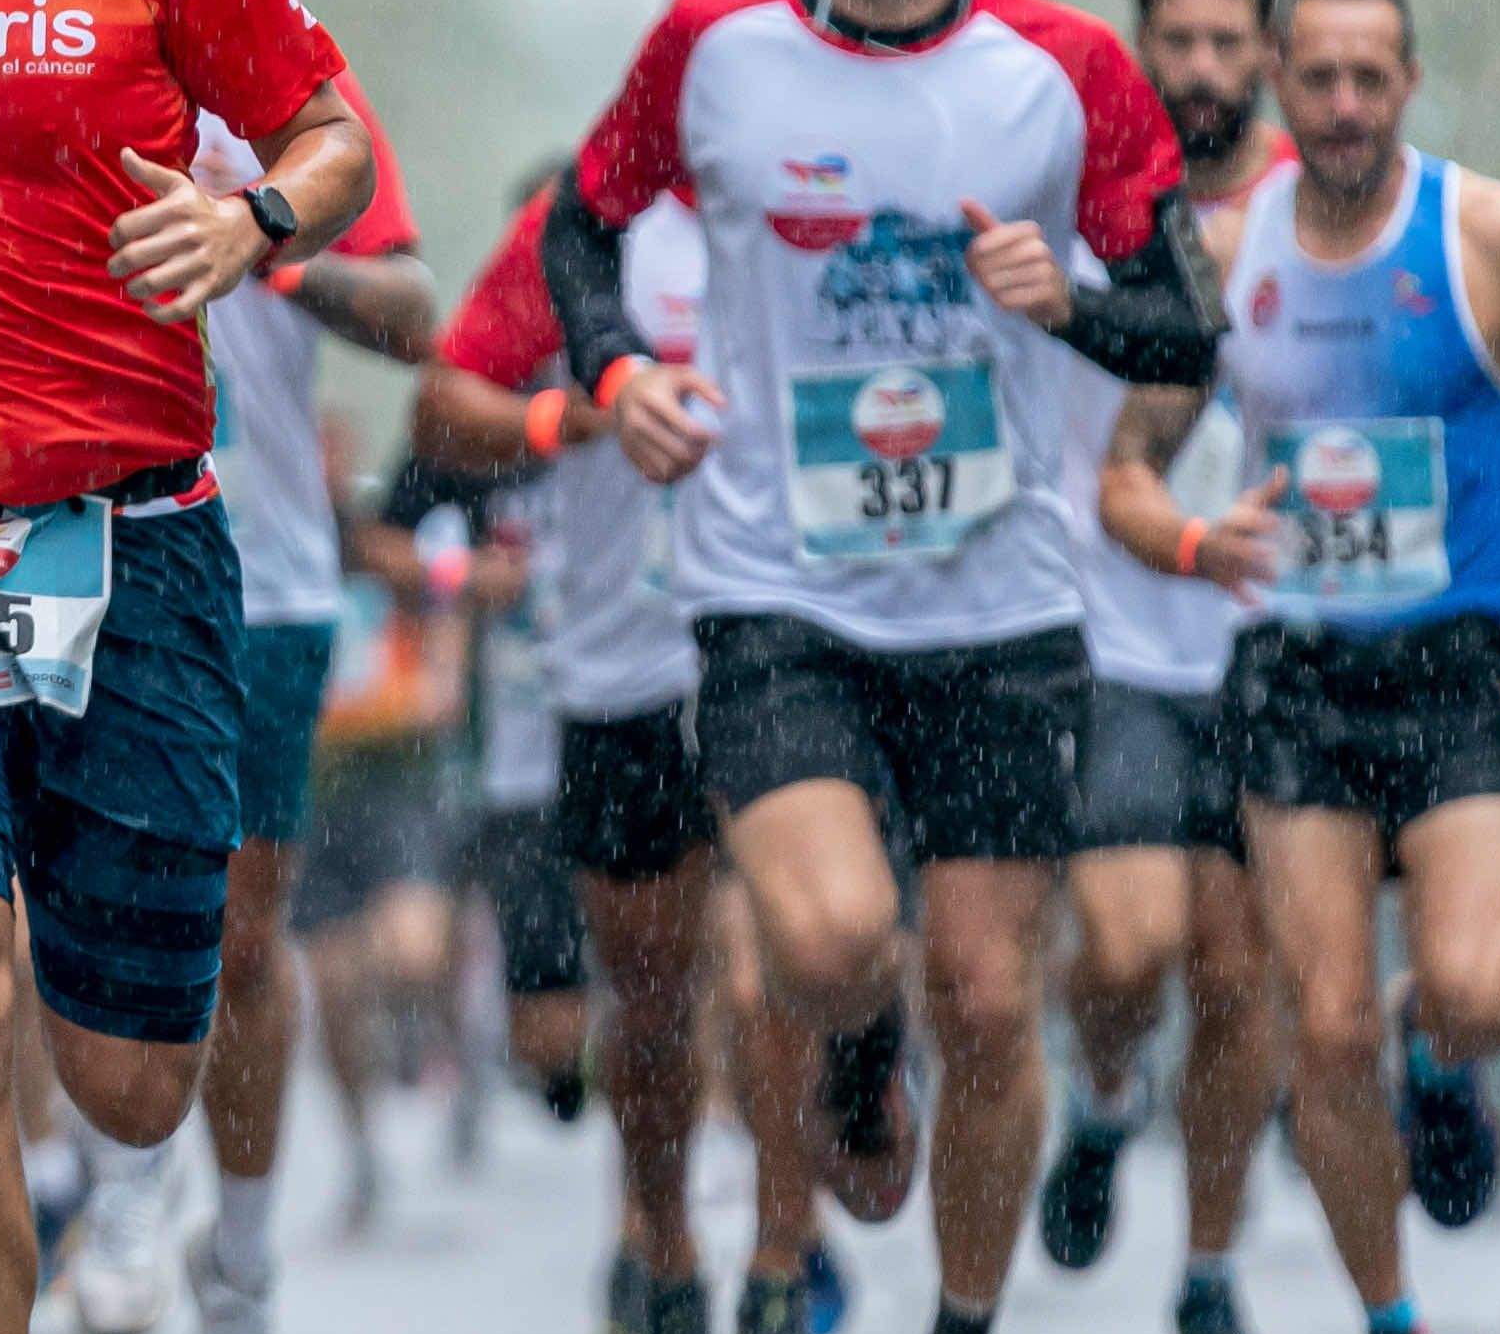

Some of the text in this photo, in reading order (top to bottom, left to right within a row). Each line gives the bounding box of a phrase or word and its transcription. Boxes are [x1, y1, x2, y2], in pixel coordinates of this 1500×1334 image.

[2, 58, 19, 75] el
[25, 58, 95, 75] cáncer
[861, 454, 953, 517] 337
